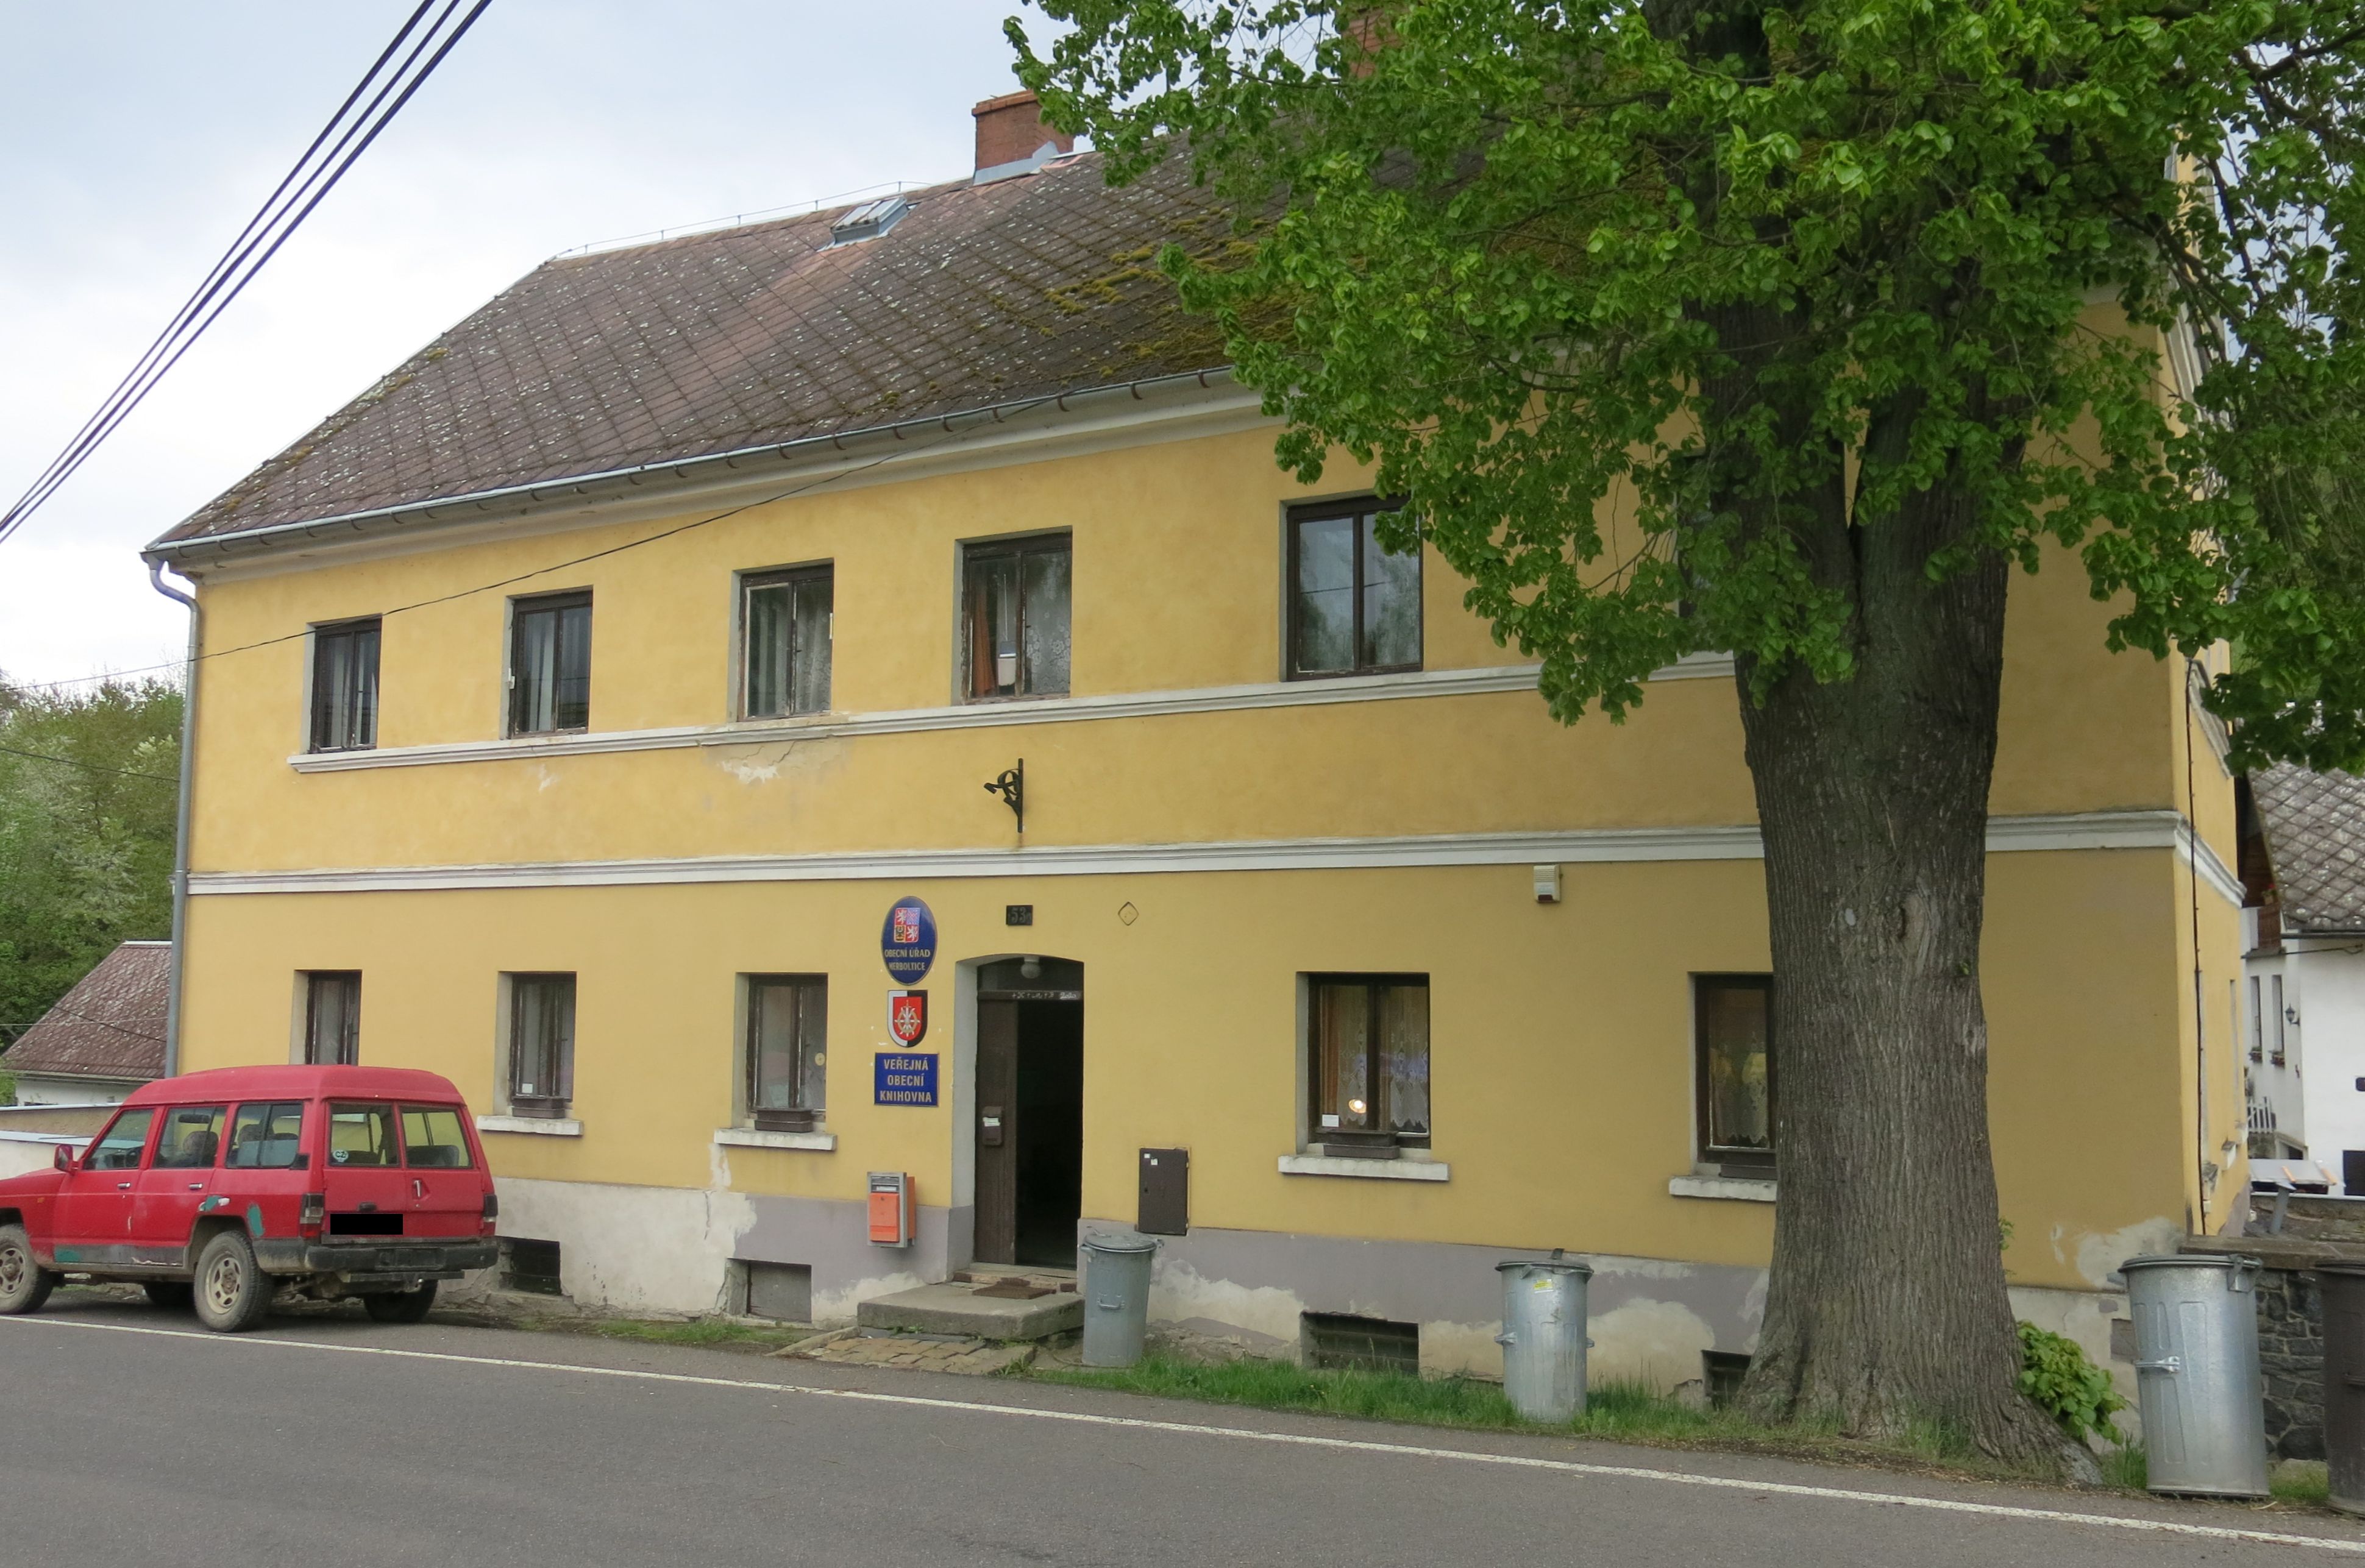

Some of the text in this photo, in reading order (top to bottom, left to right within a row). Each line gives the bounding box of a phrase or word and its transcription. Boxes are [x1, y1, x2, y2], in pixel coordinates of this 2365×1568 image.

[884, 947, 931, 957] OBECNÍ ÚŘAD
[883, 1057, 928, 1071] VEŘEJNÁ
[887, 1073, 925, 1087] OBECNÍ
[880, 1090, 932, 1102] KNIHOVNA
